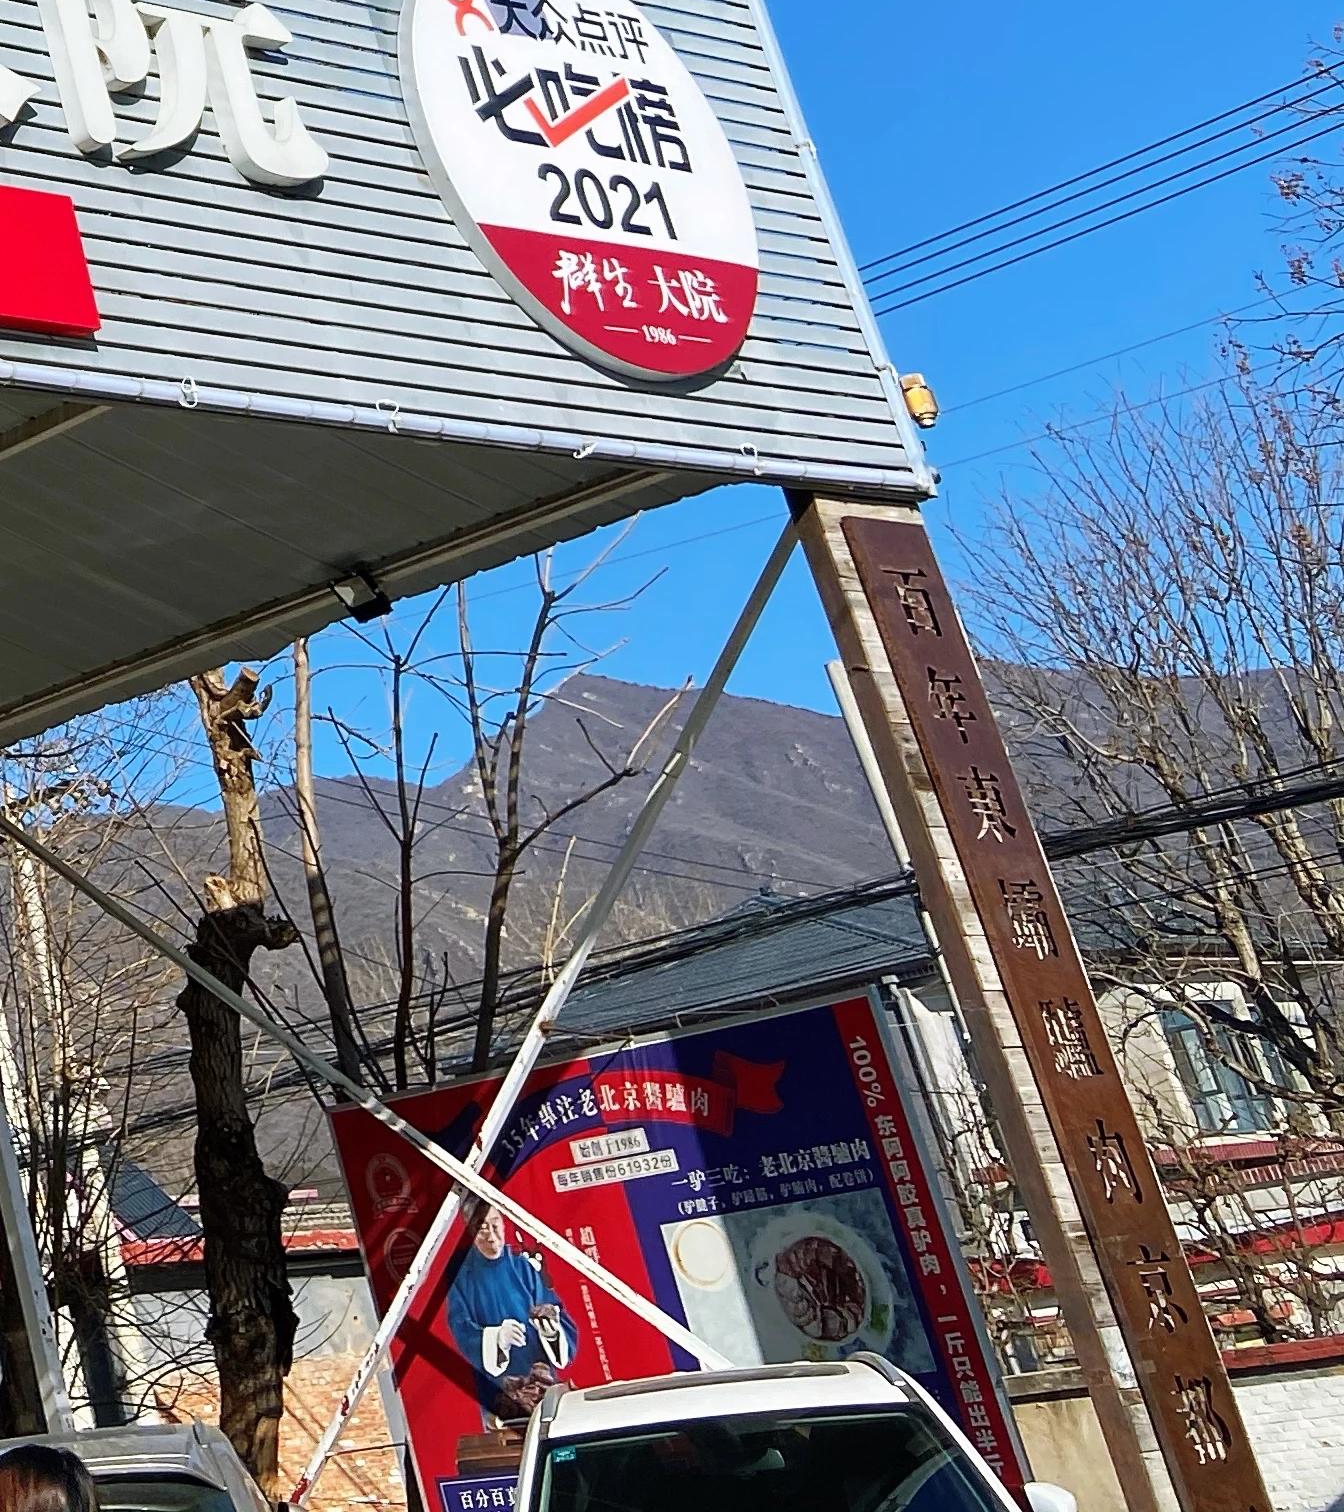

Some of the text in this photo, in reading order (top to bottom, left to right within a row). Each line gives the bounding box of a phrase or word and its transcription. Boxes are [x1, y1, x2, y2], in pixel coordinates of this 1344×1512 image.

[458, 45, 693, 174] 必吃榜
[538, 162, 678, 240] 2021
[641, 325, 677, 345] 1986
